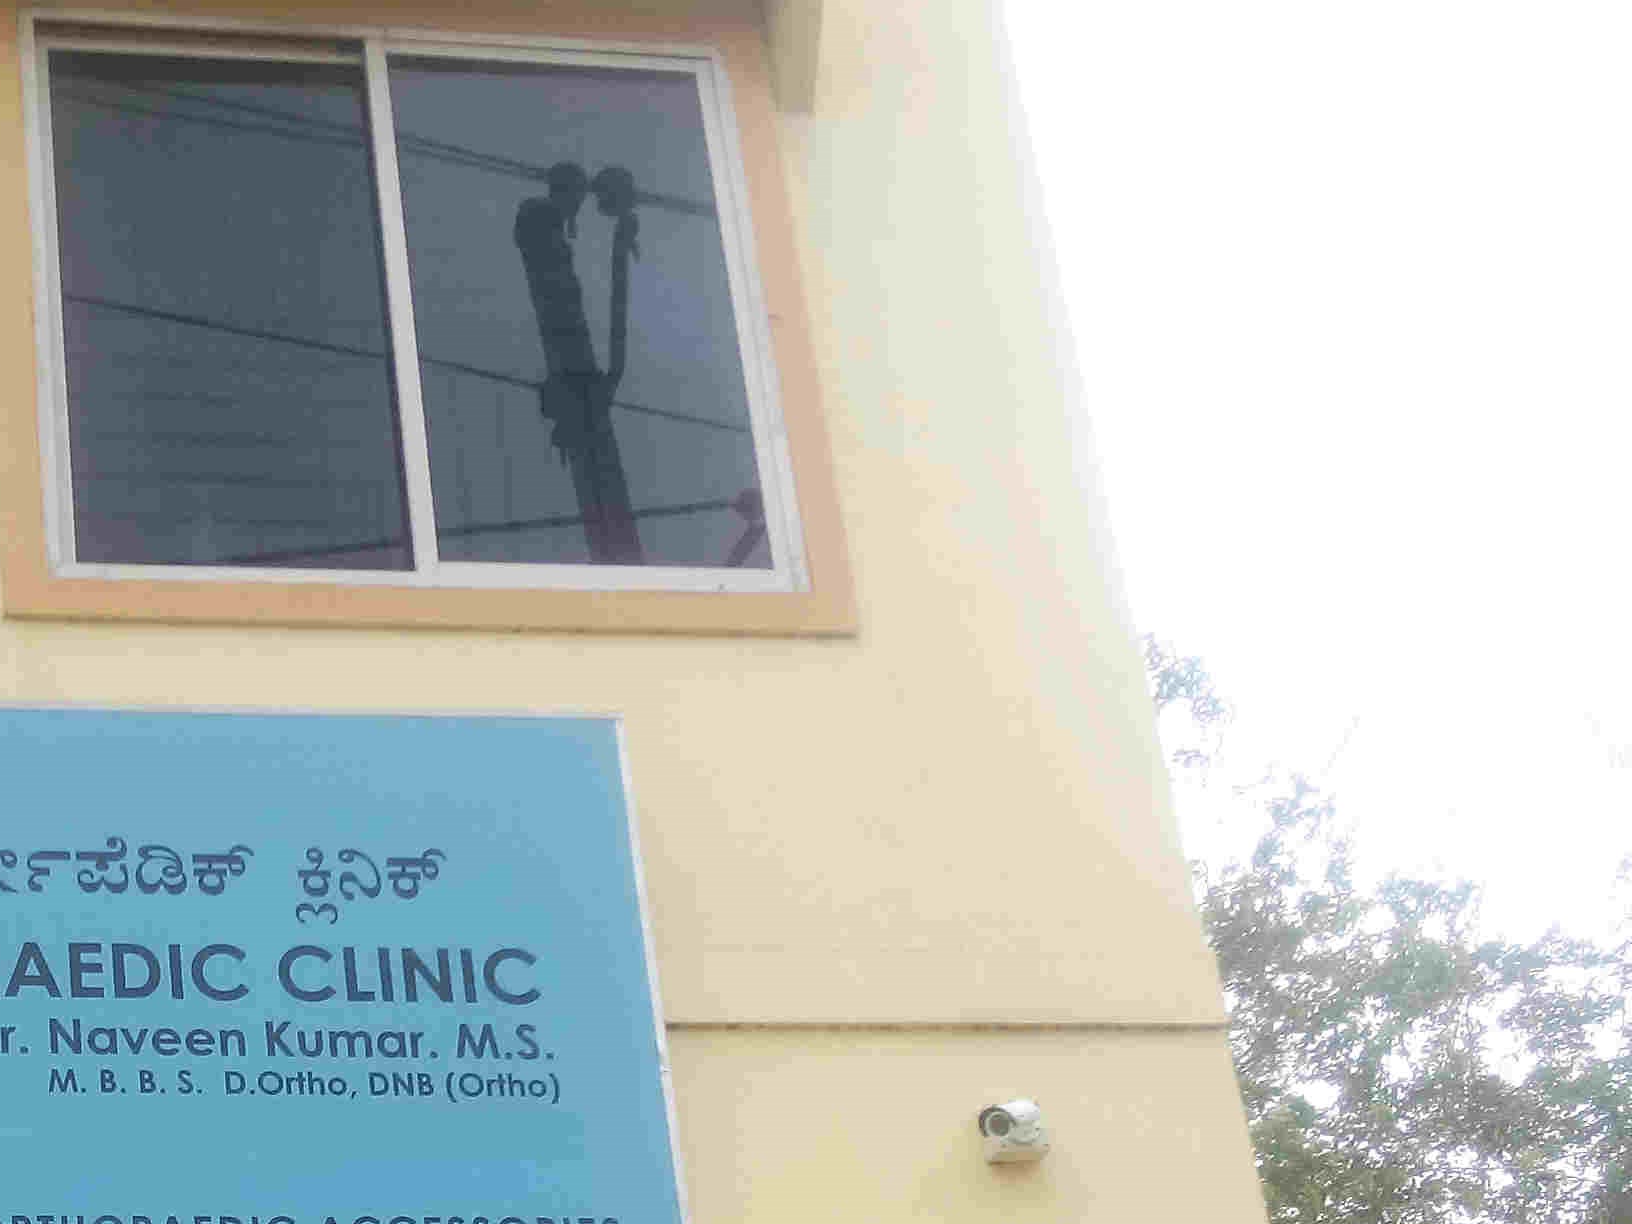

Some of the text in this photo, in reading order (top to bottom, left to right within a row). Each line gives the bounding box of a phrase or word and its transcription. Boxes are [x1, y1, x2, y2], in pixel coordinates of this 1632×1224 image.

[296, 848, 446, 924] ಕ್ಲಿನಿಕ್
[279, 945, 541, 1005] CLINIC
[49, 1018, 245, 1056] Naveen
[265, 1021, 438, 1058] Kumar.
[456, 1024, 554, 1060] M.S.
[224, 1071, 356, 1099] D.Ortho,
[369, 1072, 434, 1096] DNB
[446, 1072, 560, 1104] (Ortho)
